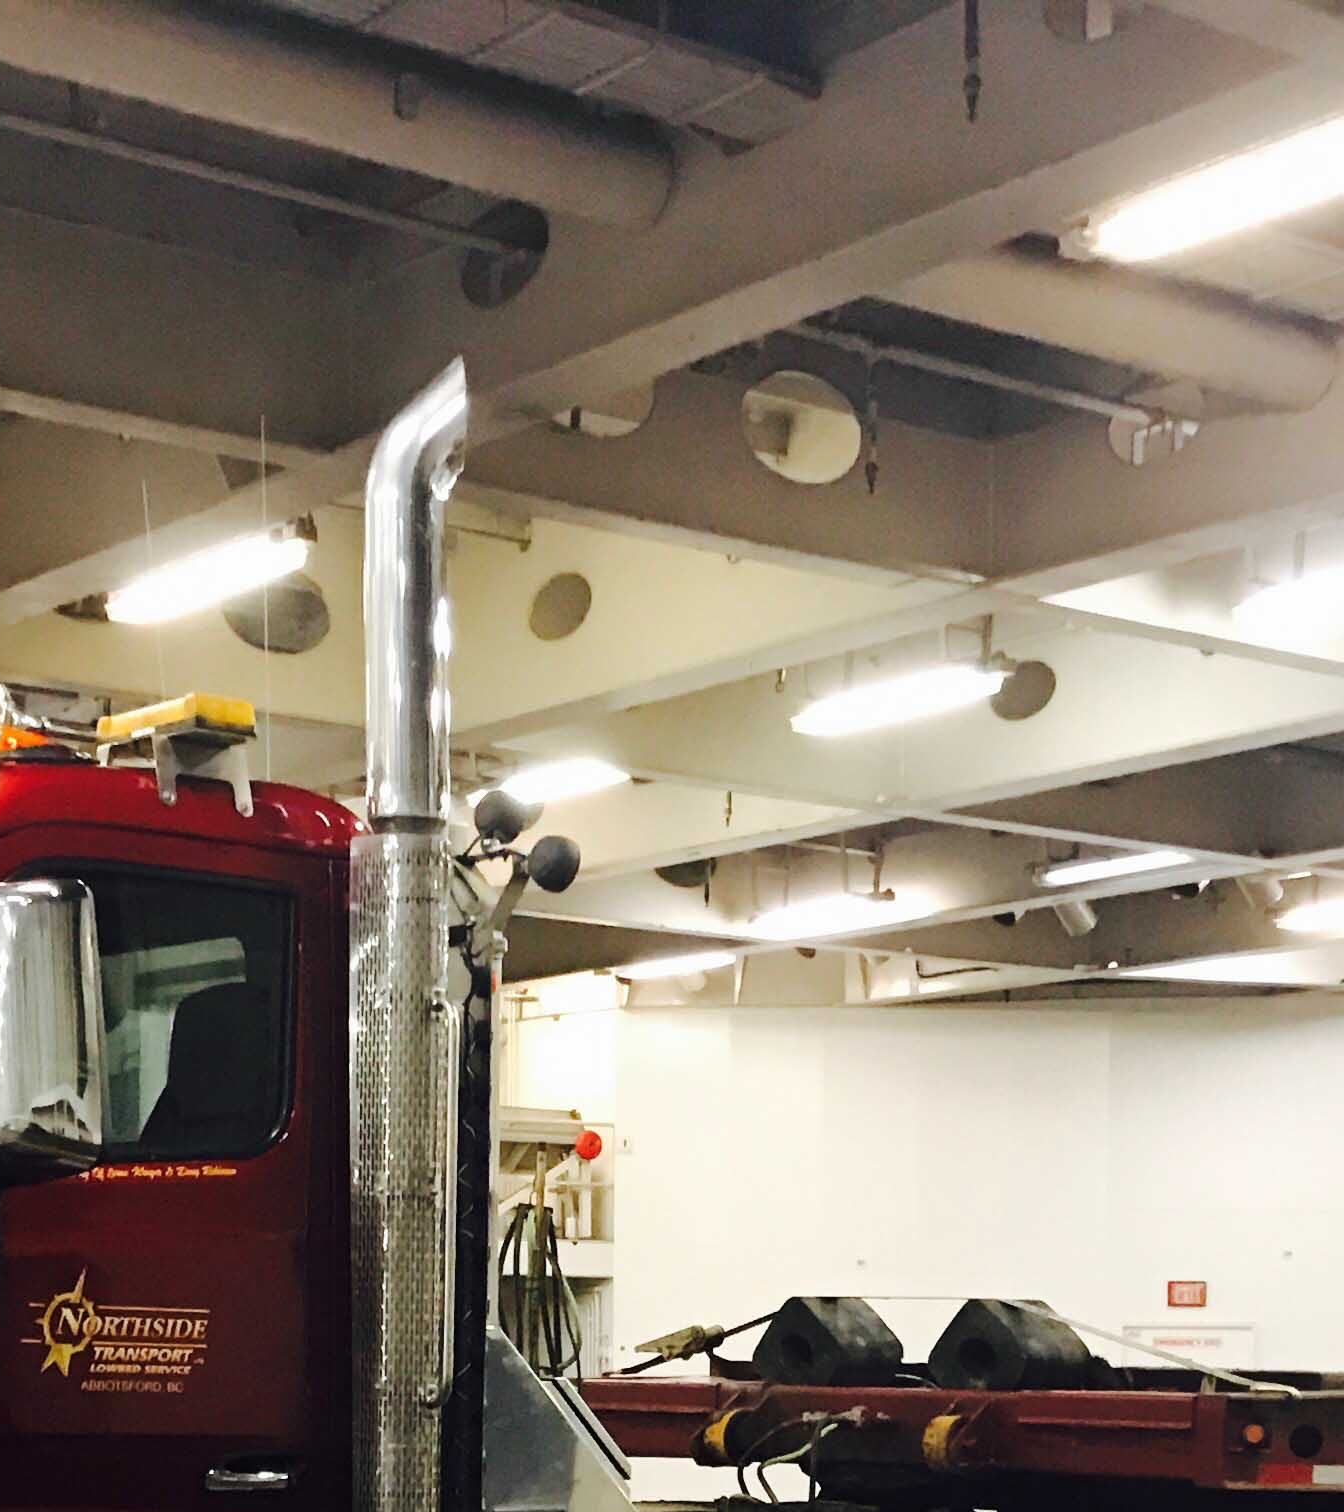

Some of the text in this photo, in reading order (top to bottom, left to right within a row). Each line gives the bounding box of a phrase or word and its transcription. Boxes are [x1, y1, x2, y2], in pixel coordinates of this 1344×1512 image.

[56, 1306, 209, 1340] NORTHSIDE
[93, 1346, 194, 1363] TRANSPORT
[144, 1364, 192, 1375] SERVICE
